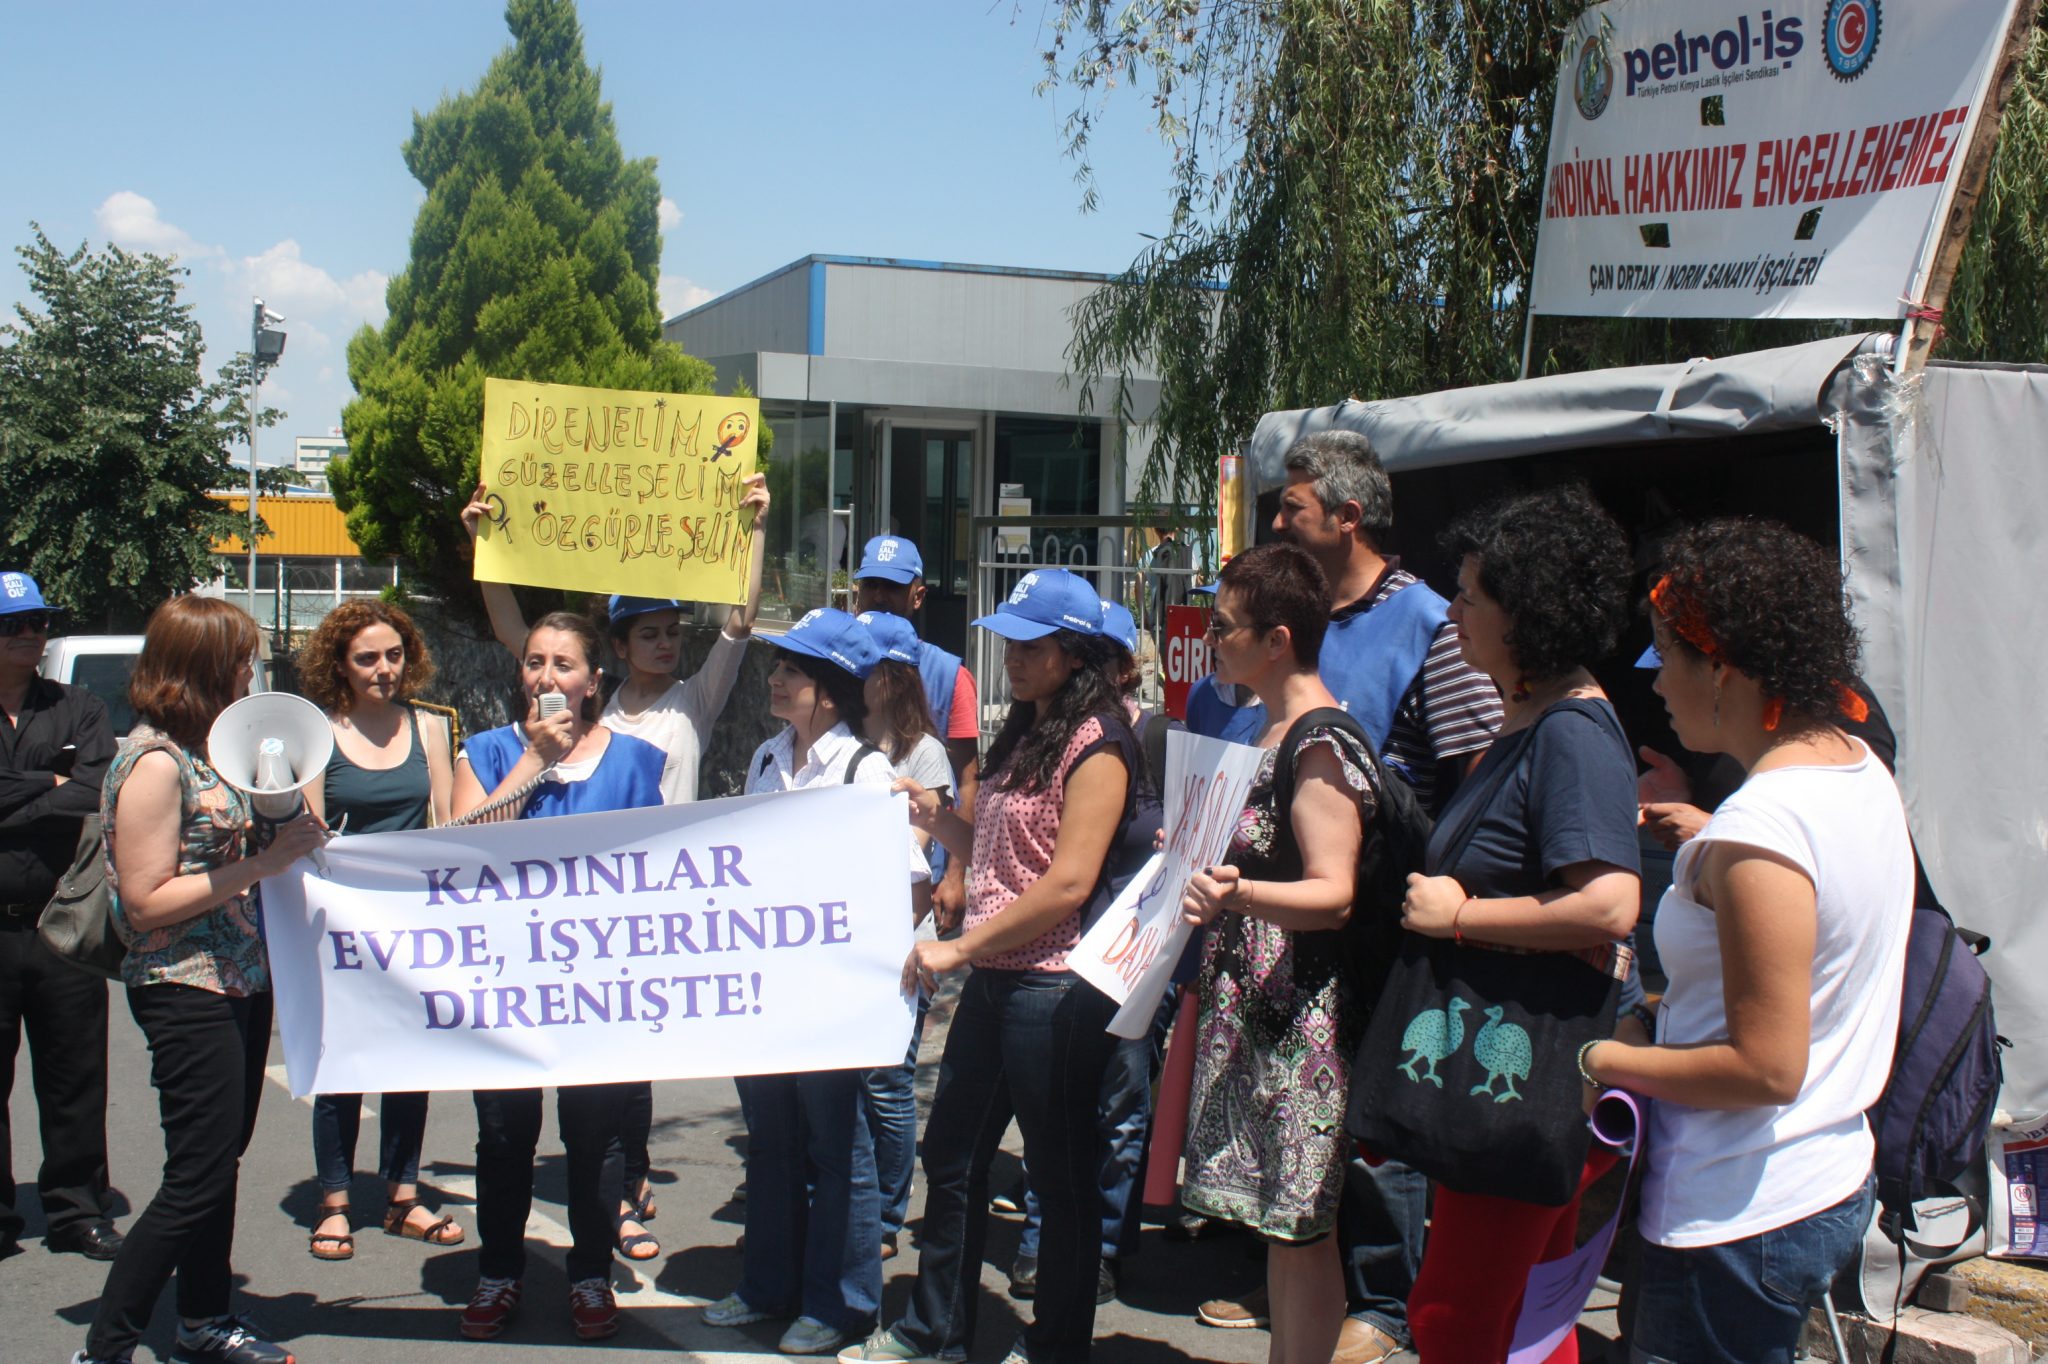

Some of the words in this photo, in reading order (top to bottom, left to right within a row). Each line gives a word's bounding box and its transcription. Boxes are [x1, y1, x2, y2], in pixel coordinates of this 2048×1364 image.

[1624, 10, 1803, 96] petrol-iş
[1637, 86, 1659, 99] Türkiye
[1660, 81, 1679, 94] Petrol
[1680, 79, 1700, 93] Kimya
[1701, 75, 1720, 89] Lastik
[1745, 66, 1779, 81] Sendikası
[1546, 147, 1620, 219] ENDİKAL
[1624, 143, 1747, 215] HAKKIMIZ
[1590, 264, 1614, 296] ÇAN
[1617, 264, 1660, 290] ORTAK
[1663, 263, 1708, 290] NORM
[1702, 254, 1762, 289] SANAYİ
[1753, 248, 1827, 295] İŞÇİLERİ
[505, 397, 702, 457] DİRENELİM
[498, 453, 743, 511] GÜZELLEŞELİM
[422, 845, 752, 906] KADINLAR
[328, 924, 507, 977] EVDE,
[526, 898, 853, 973] İŞYERİNDE
[421, 966, 764, 1033] DİRENİŞTE!
